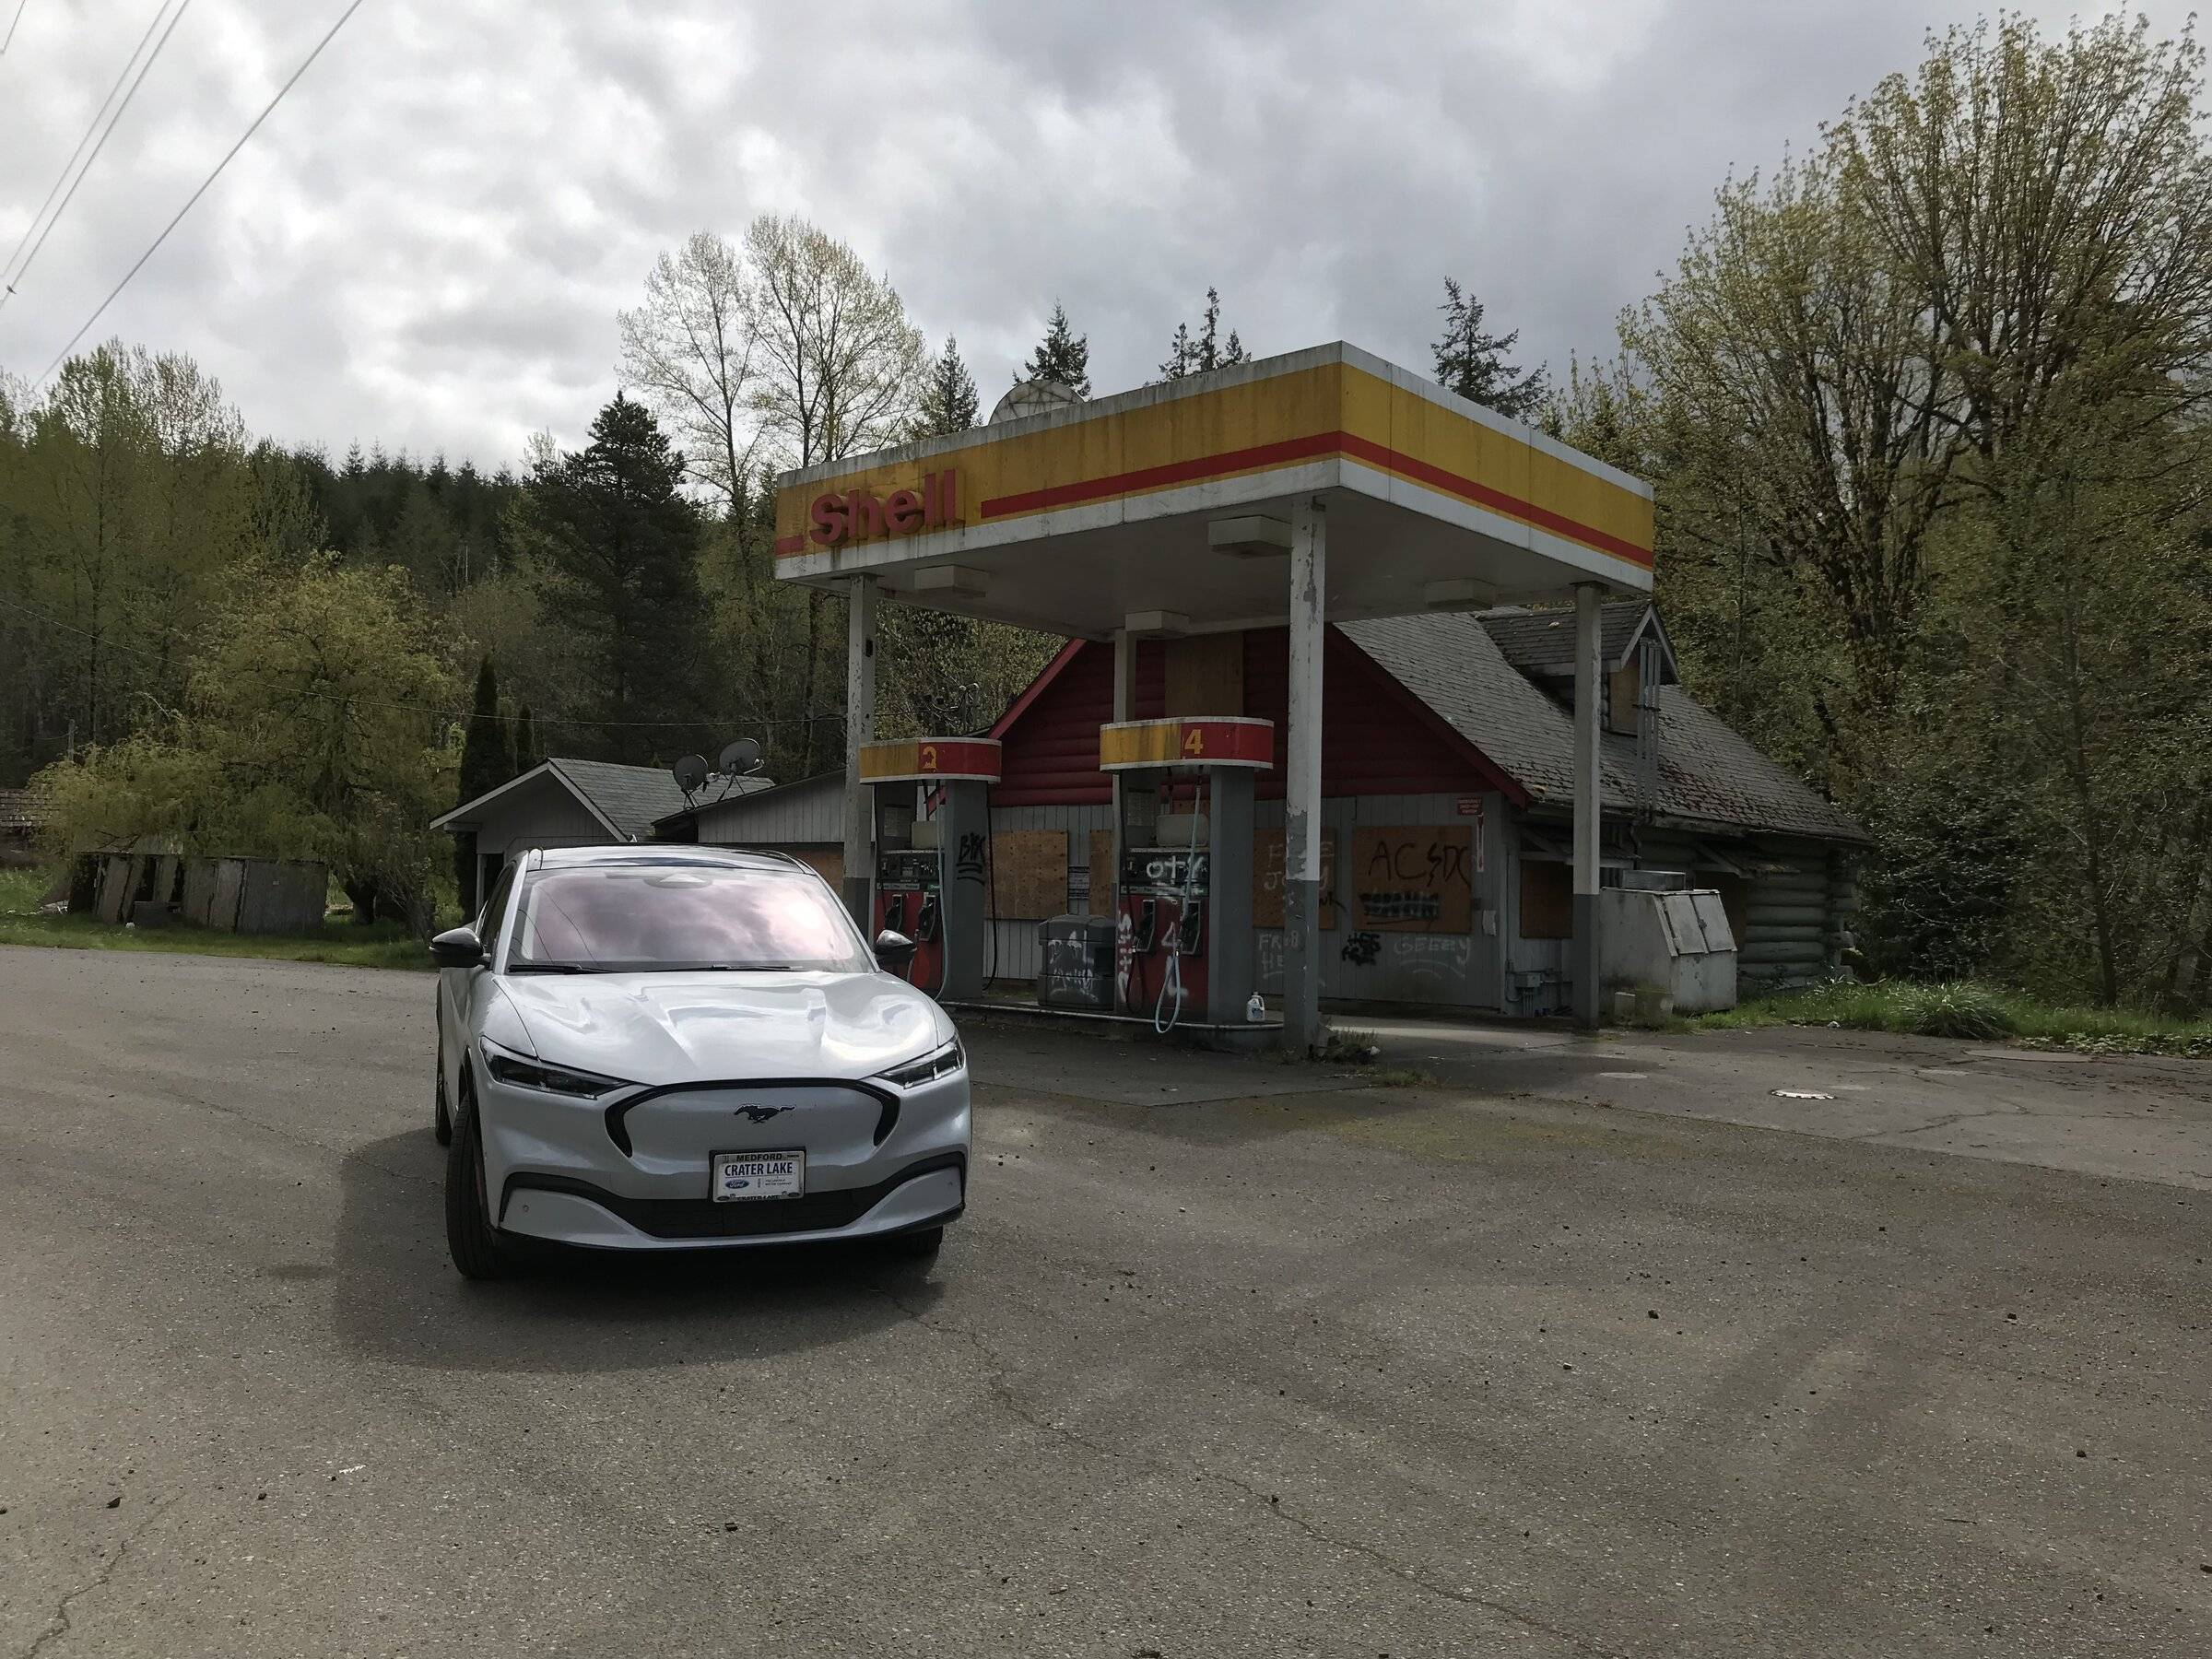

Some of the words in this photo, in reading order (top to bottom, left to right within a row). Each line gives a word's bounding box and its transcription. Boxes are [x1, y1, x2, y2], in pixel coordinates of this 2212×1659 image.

[1183, 728, 1204, 755] 4
[724, 1164, 764, 1176] CRATER
[766, 1162, 793, 1174] LAKE
